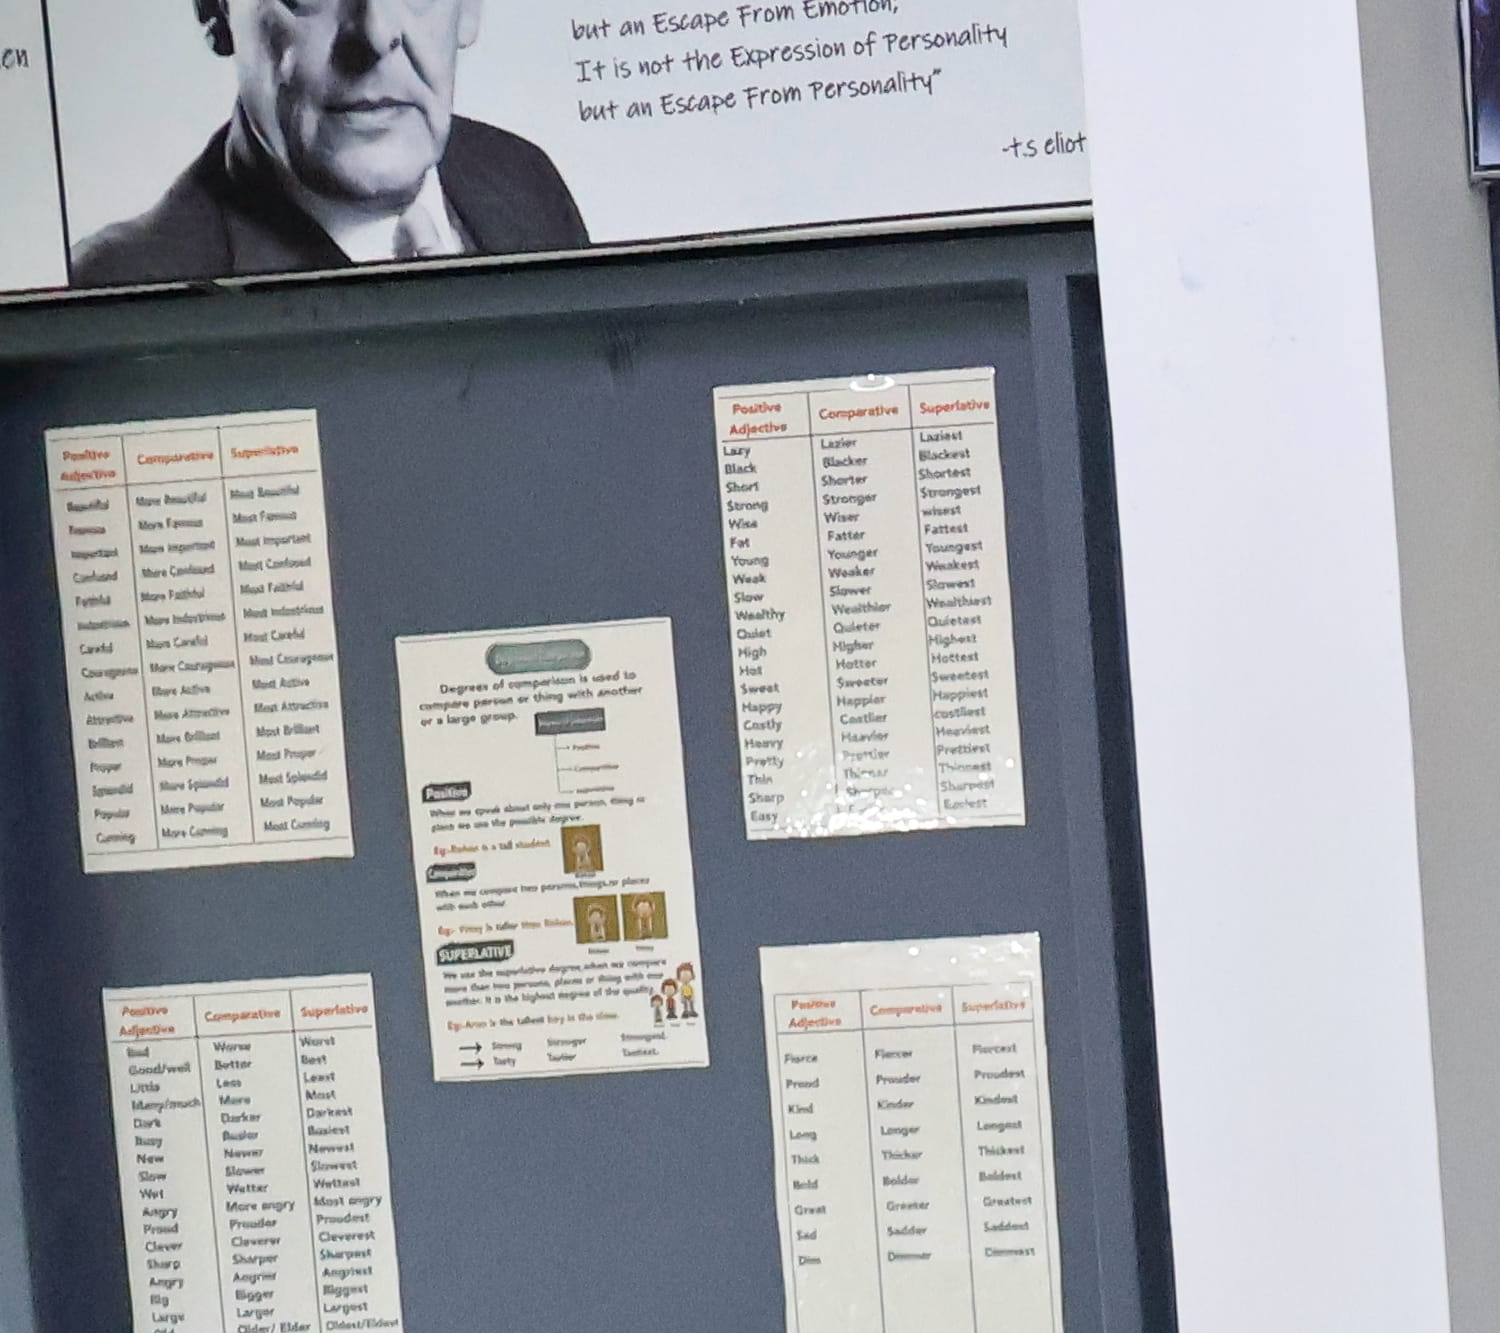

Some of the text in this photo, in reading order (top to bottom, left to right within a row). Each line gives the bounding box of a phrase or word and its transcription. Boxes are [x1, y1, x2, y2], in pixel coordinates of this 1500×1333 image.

[572, 19, 611, 41] but
[619, 20, 646, 37] an
[652, 10, 730, 36] Escape
[739, 3, 795, 25] From
[0, 48, 29, 70] en
[575, 24, 1009, 83] It is not the Expression of Personality
[579, 99, 616, 122] but
[626, 101, 653, 118] an
[660, 91, 736, 117] Escape
[743, 85, 802, 109] From
[1044, 133, 1088, 155] eliot
[732, 402, 782, 415] Positive
[819, 405, 899, 422] Comparative
[919, 400, 990, 417] Superlative
[724, 463, 757, 475] Black
